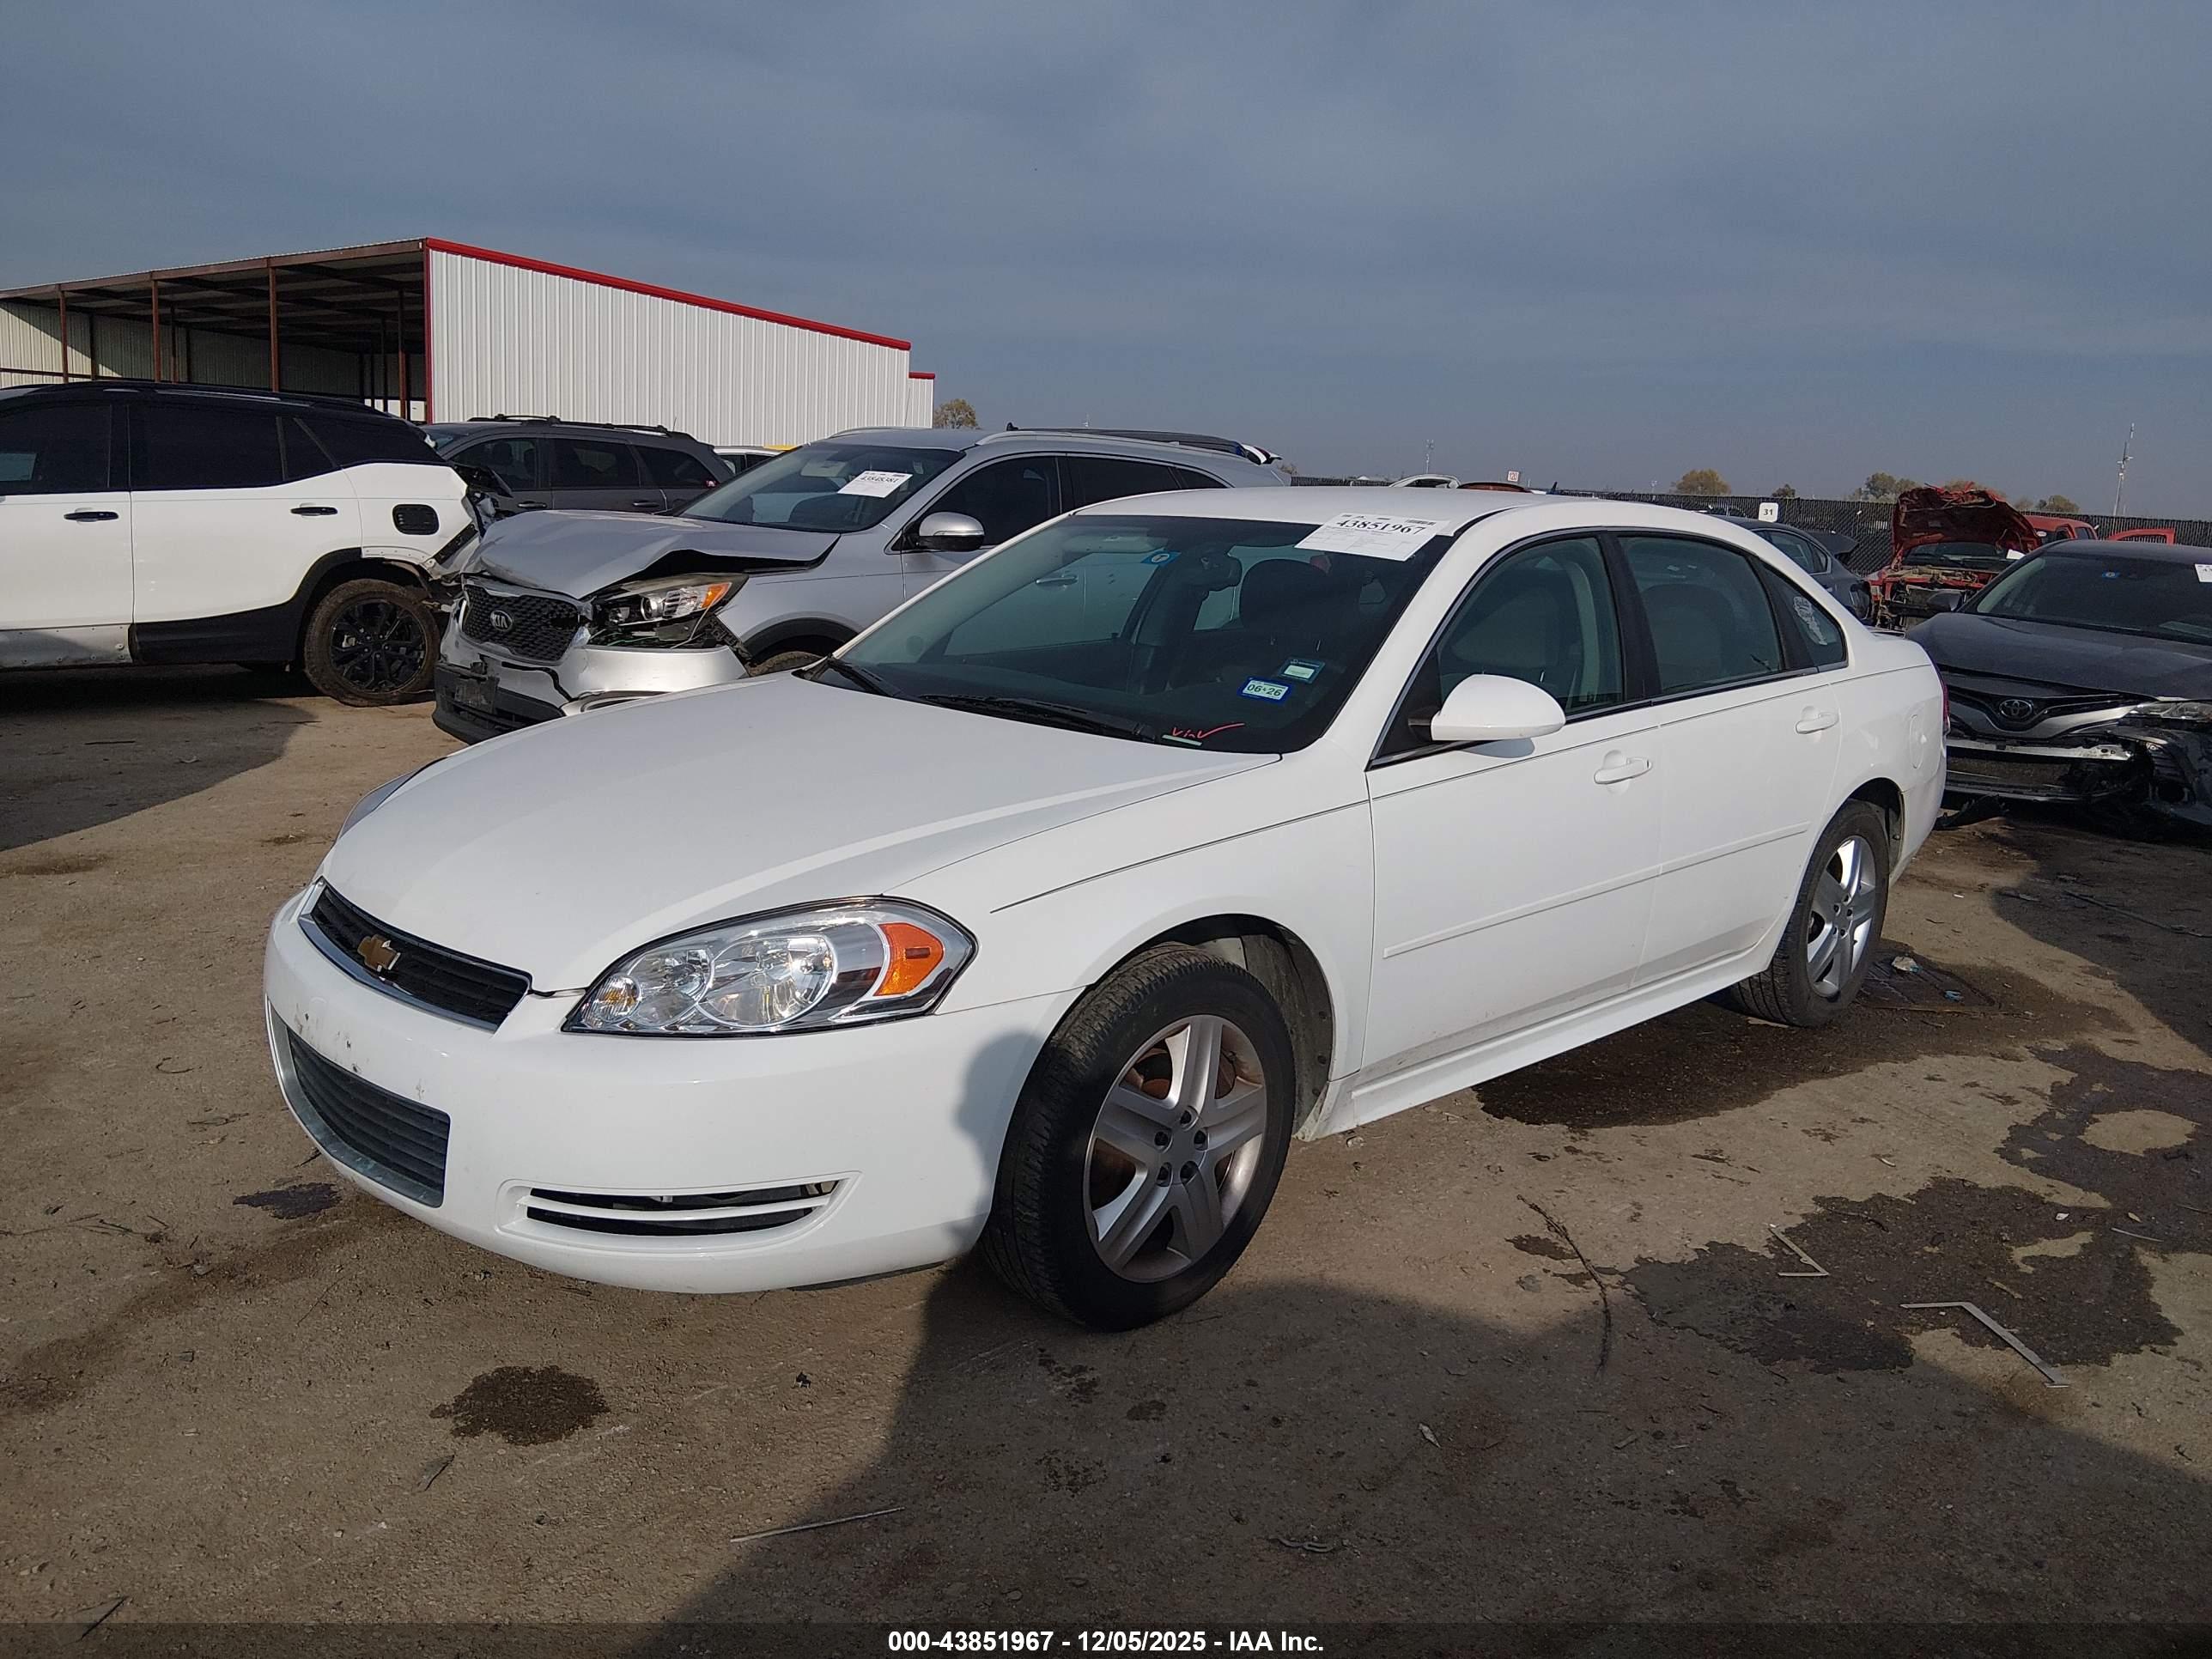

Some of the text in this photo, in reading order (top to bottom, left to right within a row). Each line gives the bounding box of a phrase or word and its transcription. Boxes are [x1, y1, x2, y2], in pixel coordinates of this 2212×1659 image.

[1336, 520, 1427, 535] 43851967
[494, 614, 508, 629] KIA
[1247, 684, 1263, 692] 06
[1266, 688, 1283, 696] 26
